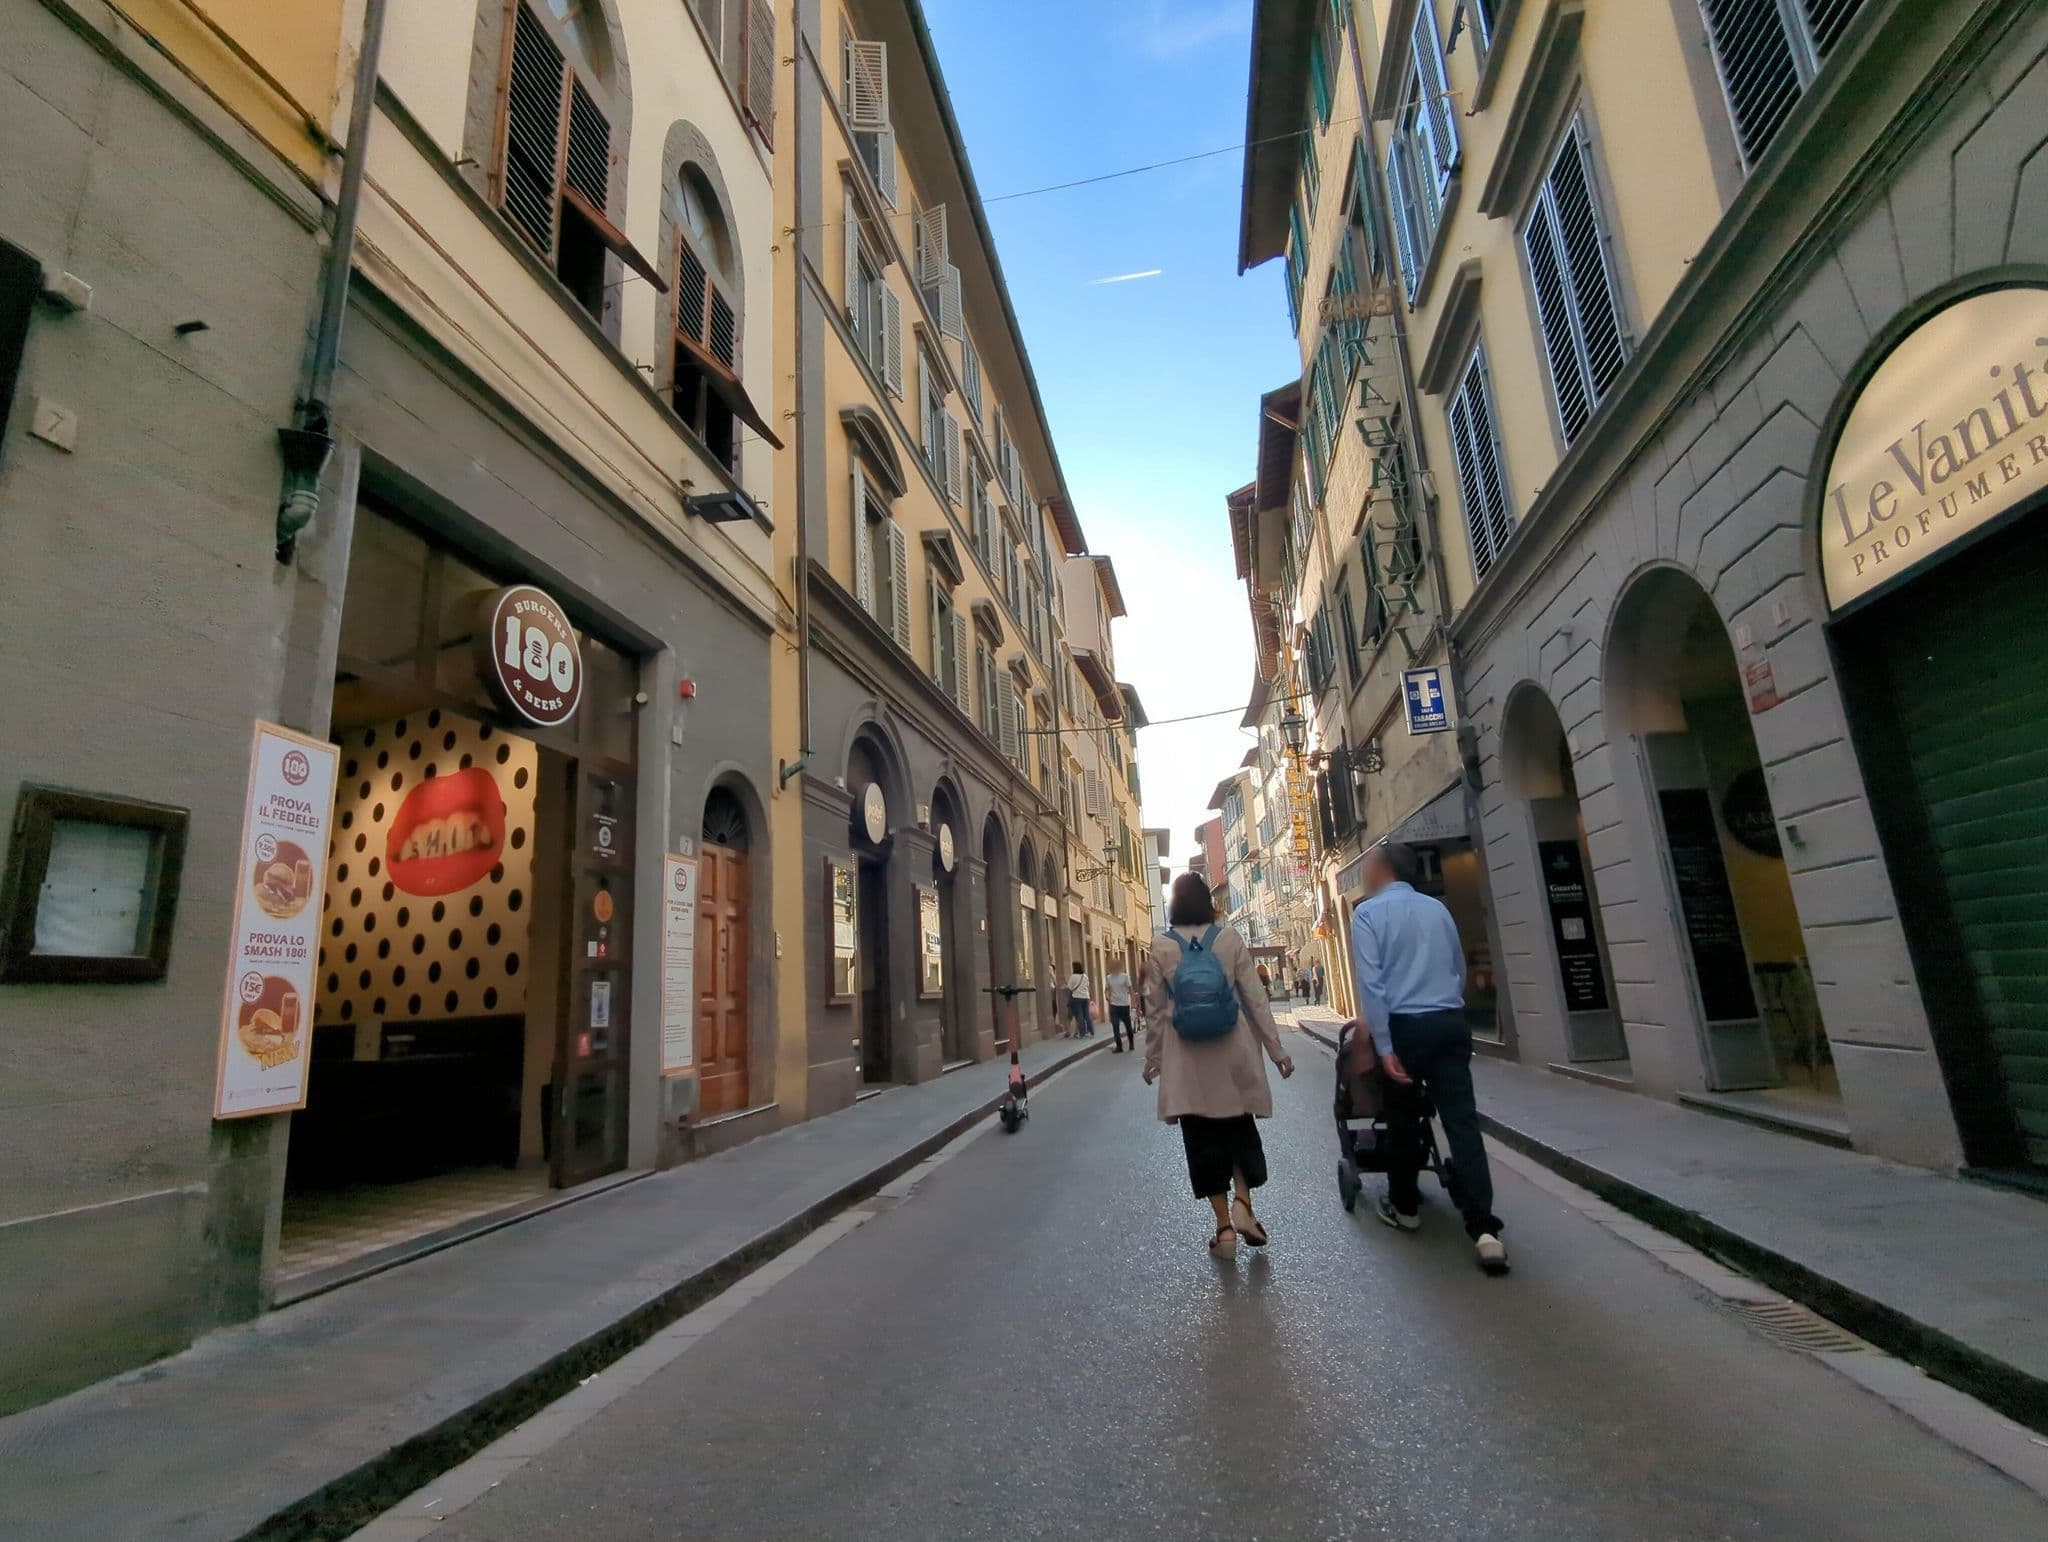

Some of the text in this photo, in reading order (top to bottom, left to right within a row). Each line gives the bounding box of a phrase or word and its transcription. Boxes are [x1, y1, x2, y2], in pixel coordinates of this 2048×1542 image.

[48, 410, 64, 432] 7
[1830, 482, 1898, 549] Le
[514, 599, 568, 640] BURGERS
[504, 615, 574, 693] 180
[513, 678, 564, 711] & BEERS
[1408, 672, 1437, 708] T
[270, 794, 312, 814] PROVA
[259, 805, 269, 818] IL
[272, 809, 320, 829] FEDELE!
[249, 933, 305, 945] PROVA LO
[244, 945, 307, 959] SMASH 180!
[244, 981, 262, 994] 15€
